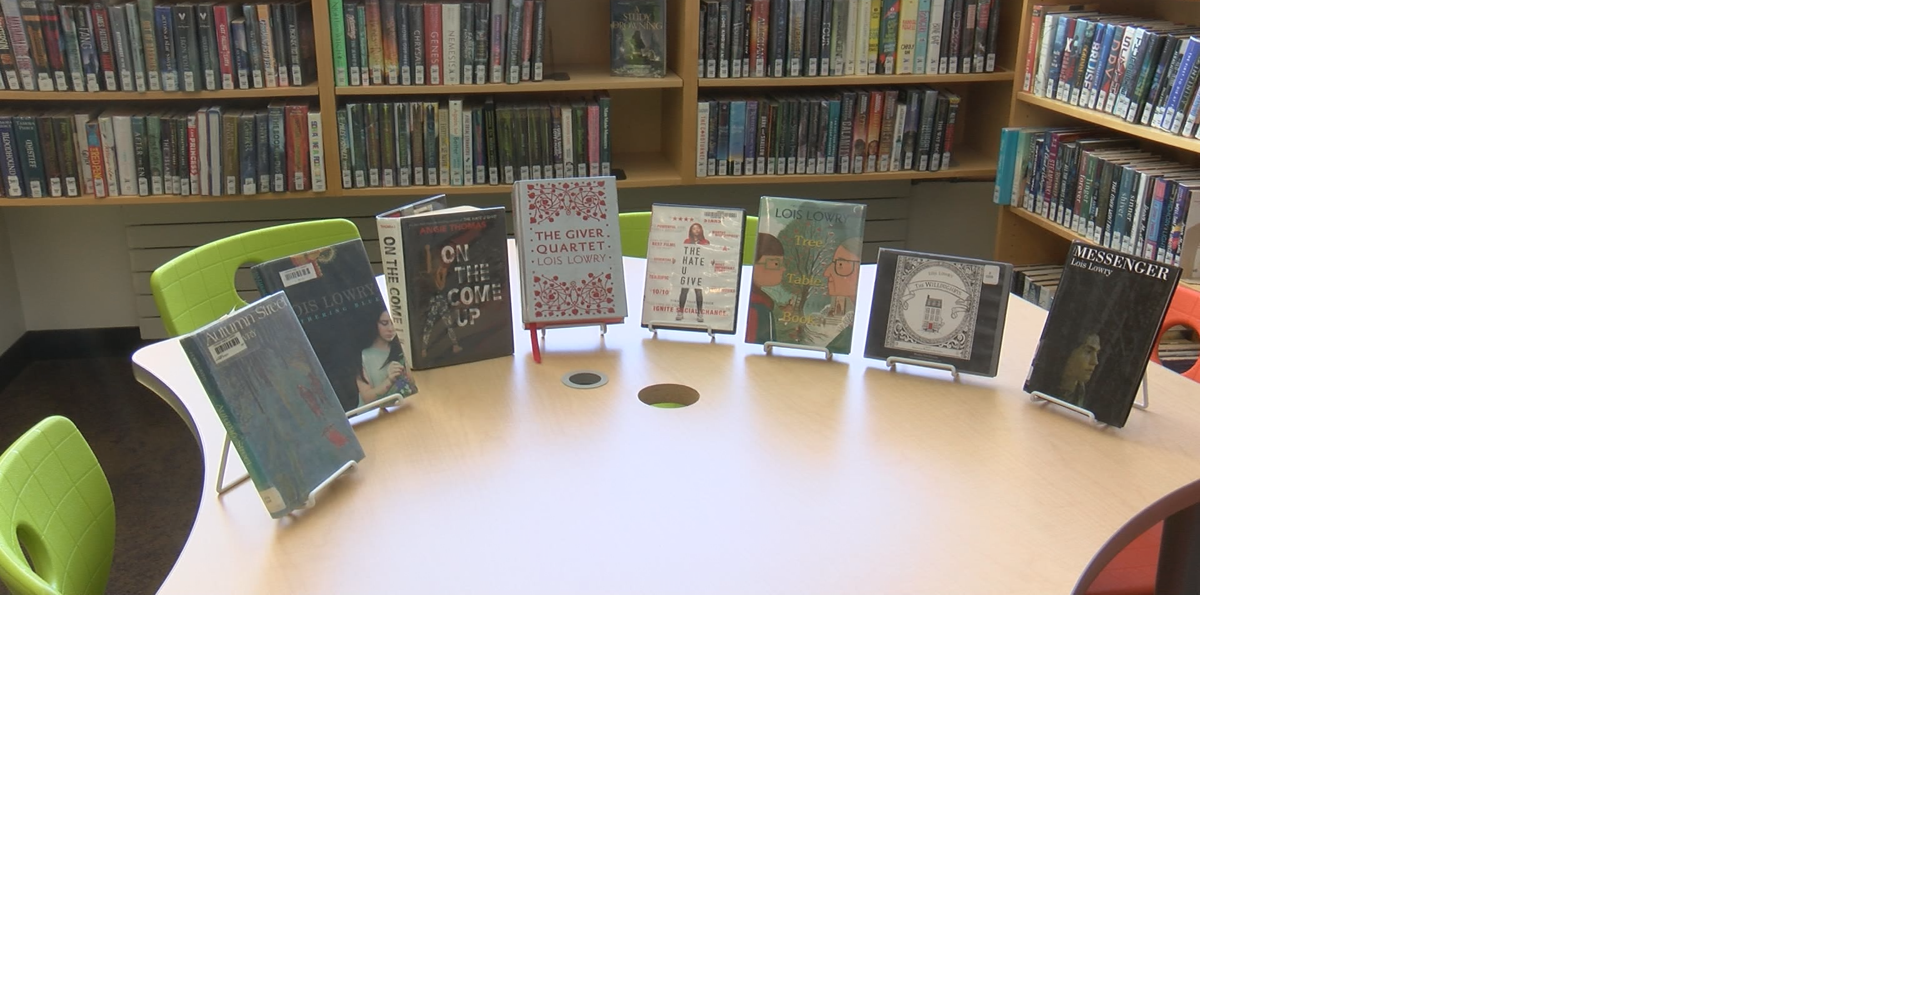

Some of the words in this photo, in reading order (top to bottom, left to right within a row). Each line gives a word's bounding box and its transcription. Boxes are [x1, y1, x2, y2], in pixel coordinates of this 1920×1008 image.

[78, 27, 92, 49] FANG
[756, 16, 766, 59] ALLEGIAN
[793, 16, 802, 58] DIVERGEN
[821, 22, 831, 46] FOUR
[413, 30, 422, 66] CHRYSAL
[430, 31, 440, 64] GENES
[448, 30, 456, 68] NEMESIS
[1083, 41, 1100, 90] BRUISE
[134, 132, 143, 155] AFTER
[839, 121, 852, 157] CALAMITY
[2, 132, 17, 175] BLOODHOUND
[164, 154, 172, 176] ISLAN
[188, 137, 197, 173] PRINCESS
[1076, 174, 1087, 203] forever
[1083, 178, 1093, 204] linger
[775, 208, 803, 220] LOIS
[807, 210, 849, 224] LOWRY
[1118, 193, 1128, 218] shiver
[1126, 195, 1136, 222] sinner
[419, 224, 448, 236] ANGIE
[449, 220, 487, 232] THOMAS
[535, 230, 561, 240] THE
[565, 228, 604, 239] GIVER
[383, 236, 396, 256] ON
[441, 244, 470, 264] ON
[536, 241, 605, 254] QUARTET
[684, 246, 701, 256] THE
[386, 260, 399, 284] THE
[537, 256, 563, 266] LOIS
[567, 254, 606, 265] LOWRY
[681, 266, 687, 275] U
[682, 256, 705, 266] HATE
[1070, 258, 1087, 269] Lois
[1088, 262, 1113, 277] Lowry
[1073, 245, 1170, 281] MESSENGER
[454, 263, 491, 285] THE
[680, 276, 702, 286] GIVE
[296, 299, 320, 317] OIS
[322, 282, 376, 309] LOWRY
[447, 283, 503, 307] COME
[652, 288, 670, 296] 10/10
[389, 287, 403, 325] COME
[456, 307, 481, 328] UP
[676, 307, 698, 315] SOCIAL
[205, 313, 256, 343] Autumn
[254, 297, 288, 320] Street
